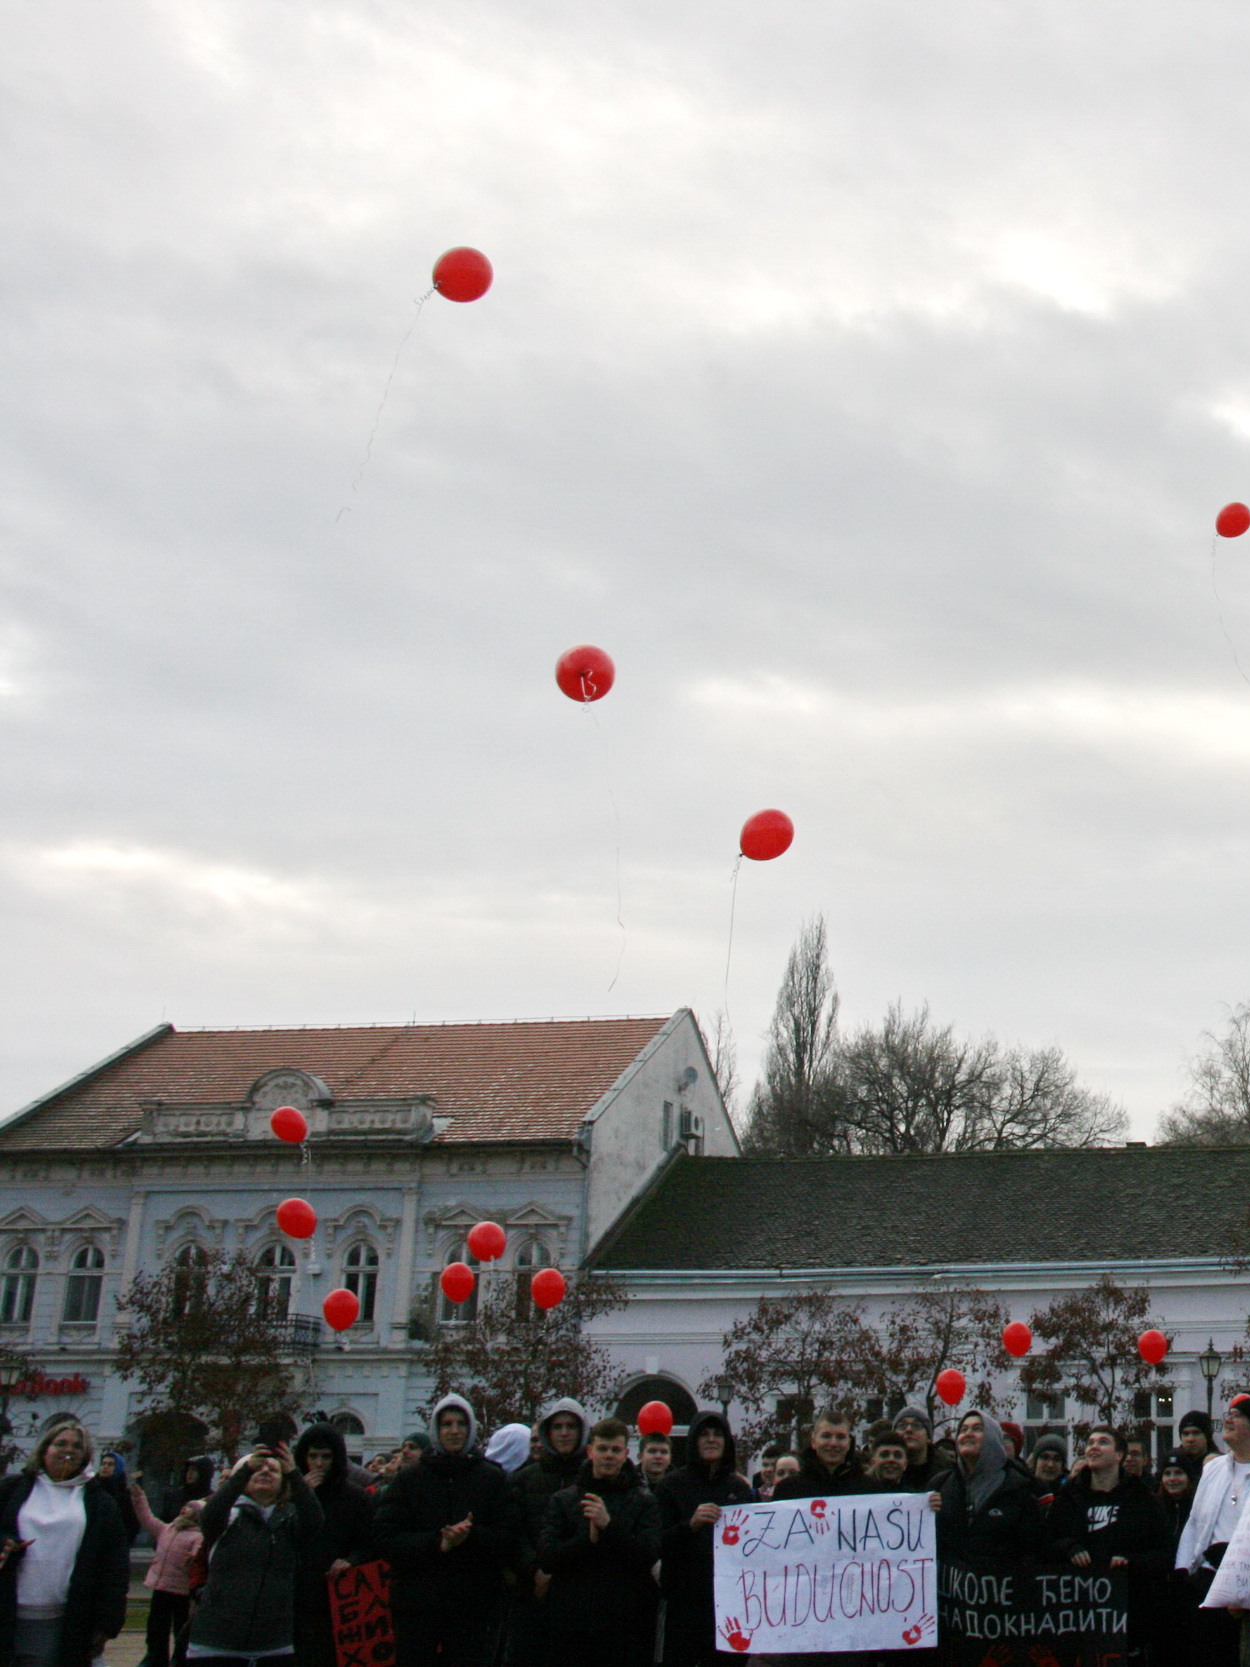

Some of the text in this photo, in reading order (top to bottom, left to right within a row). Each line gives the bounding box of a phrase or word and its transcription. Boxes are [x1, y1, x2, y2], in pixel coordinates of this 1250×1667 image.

[742, 1501, 925, 1557] ZA NAŠU
[736, 1555, 934, 1631] BUDUĆNOST
[1035, 1574, 1113, 1607] ЋЕМО
